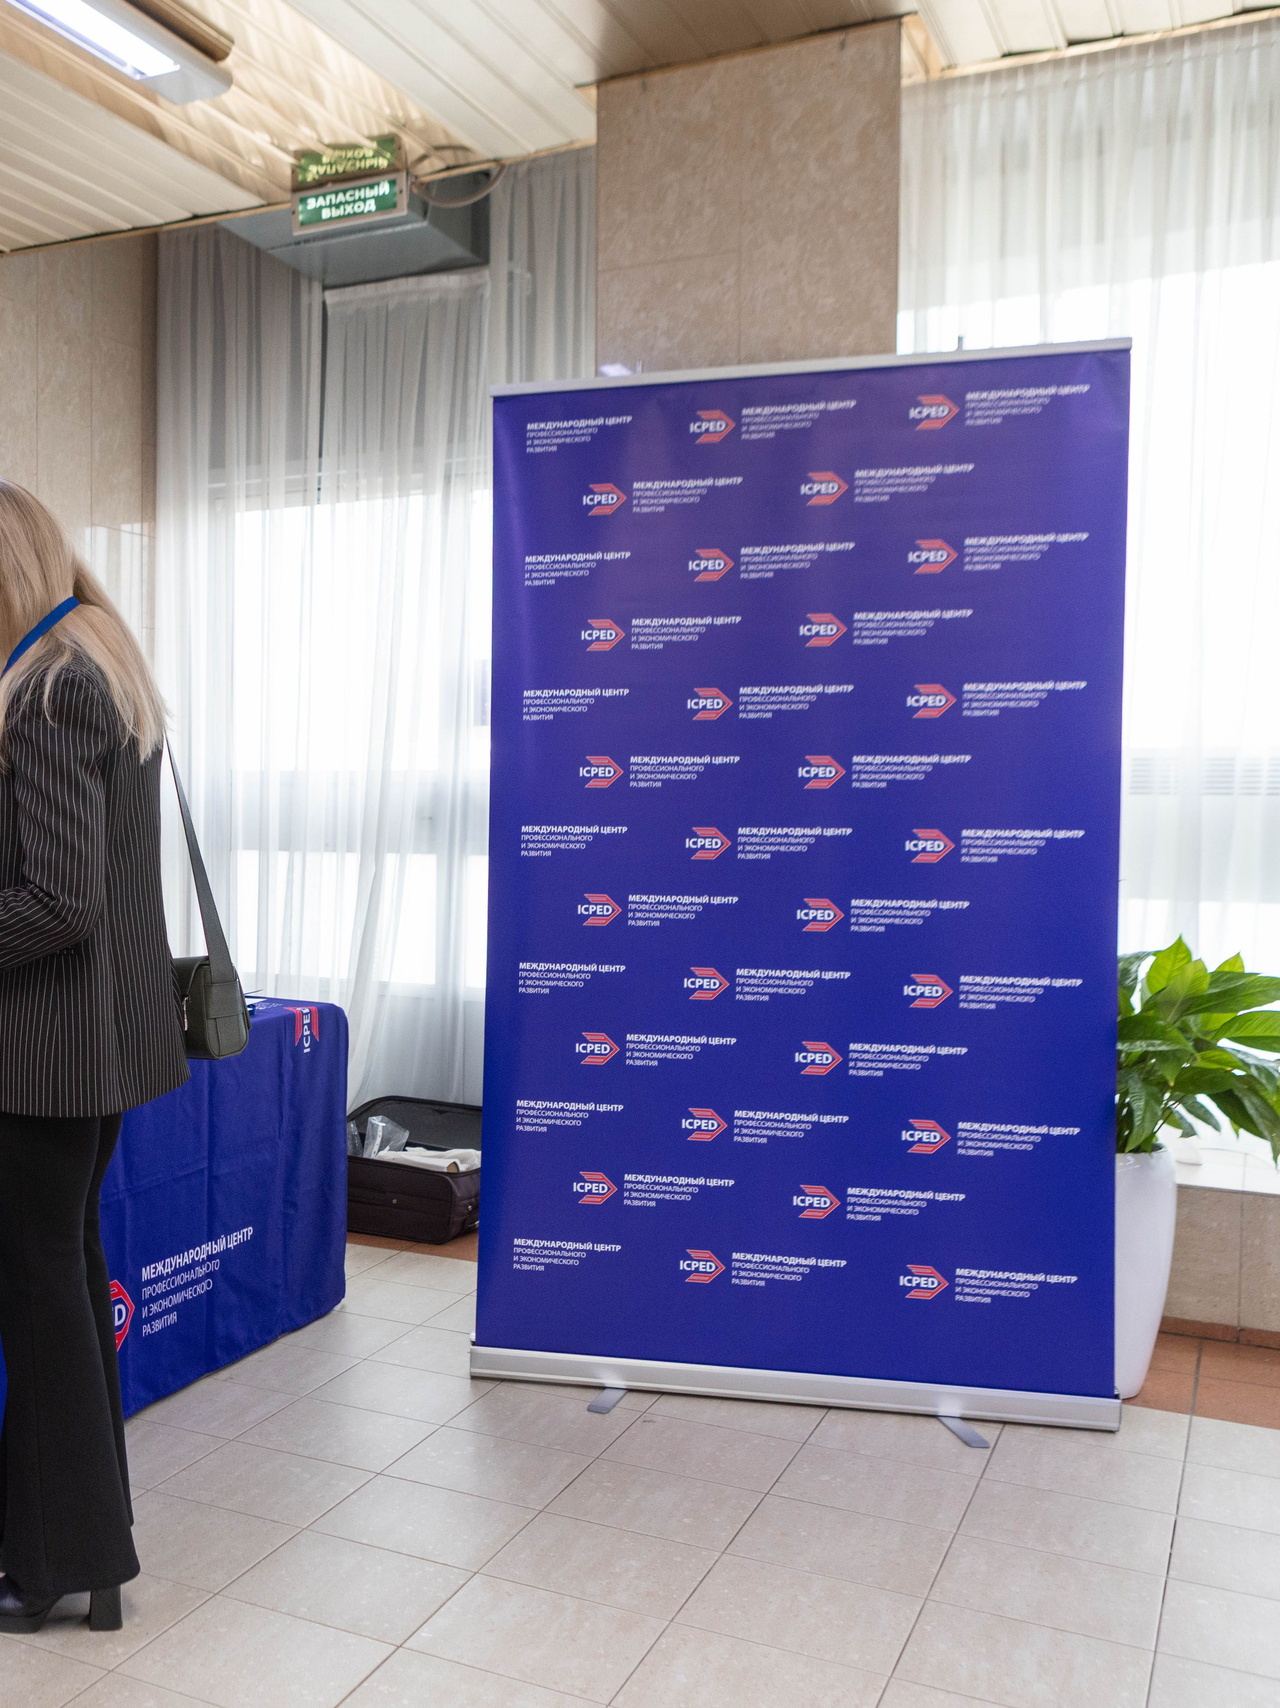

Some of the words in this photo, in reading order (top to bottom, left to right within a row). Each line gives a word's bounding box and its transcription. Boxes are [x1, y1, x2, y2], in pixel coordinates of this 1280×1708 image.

[307, 180, 390, 210] ЗАПАСНЫЙ
[321, 198, 376, 220] ВЫХОД
[910, 404, 949, 418] ICPED
[526, 417, 604, 430] МЕЖДУНАРОДНЫЙ
[605, 415, 632, 425] ЦЕНТР
[690, 420, 726, 432] ICPED
[632, 477, 713, 490] МЕЖДУНАРОДНЫЙ
[714, 476, 743, 486] ЦЕНТР
[801, 481, 838, 494] ICPED
[583, 493, 617, 505] ICPED
[740, 542, 824, 555] МЕЖДУНАРОДНЫЙ
[825, 541, 855, 551] ЦЕНТР
[524, 551, 602, 563] МЕЖДУНАРОДНЫЙ
[603, 551, 631, 560] ЦЕНТР
[908, 549, 947, 562] ICPED
[689, 559, 724, 570] ICPED
[631, 615, 712, 627] МЕЖДУНАРОДНЫЙ
[713, 615, 741, 625] ЦЕНТР
[581, 629, 615, 640] ICPED
[800, 624, 837, 635] ICPED
[523, 687, 601, 698] МЕЖДУНАРОДНЫЙ
[601, 688, 629, 697] ЦЕНТР
[739, 684, 823, 695] МЕЖДУНАРОДНЫЙ
[823, 684, 854, 693] ЦЕНТР
[522, 697, 594, 705] ПРОФЕССИОНАЛЬНОГО
[688, 698, 722, 709] ICPED
[907, 695, 946, 706] ICPED
[528, 705, 587, 713] ЭКОНОМИЧЕСКОГО
[629, 754, 710, 765] МЕЖДУНАРОДНЫЙ
[711, 755, 740, 764] ЦЕНТР
[851, 753, 939, 764] МЕЖДУНАРОДНЫЙ
[940, 754, 971, 764] ЦЕНТР
[580, 766, 614, 776] ICPED
[799, 766, 835, 777] ICPED
[521, 824, 599, 833] МЕЖДУНАРОДНЫЙ
[600, 825, 627, 834] ЦЕНТР
[737, 826, 822, 836] МЕЖДУНАРОДНЫЙ
[822, 827, 852, 836] ЦЕНТР
[686, 837, 721, 848] ICPED
[905, 840, 944, 851] ICPED
[628, 894, 709, 903] МЕЖДУНАРОДНЫЙ
[710, 895, 738, 904] ЦЕНТР
[850, 898, 938, 908] МЕЖДУНАРОДНЫЙ
[938, 900, 969, 909] ЦЕНТР
[578, 904, 612, 914] ICPED
[627, 903, 702, 911] ПРОФЕССИОНАЛЬНОГО
[634, 911, 695, 919] ЭКОНОМИЧЕСКОГО
[797, 909, 834, 920] ICPED
[518, 962, 597, 971] МЕЖДУНАРОДНЫЙ
[598, 964, 625, 972] ЦЕНТР
[518, 971, 591, 979] ПРОФЕССИОНАЛЬНОГО
[735, 968, 820, 978] МЕЖДУНАРОДНЫЙ
[821, 970, 851, 980] ЦЕНТР
[524, 979, 584, 987] ЭКОНОМИЧЕСКОГО
[684, 977, 719, 988] ICPED
[518, 986, 549, 994] РАЗВИТИЯ
[904, 985, 942, 996] ICPED
[626, 1033, 707, 1044] МЕЖДУНАРОДНЫЙ
[708, 1036, 736, 1045] ЦЕНТР
[576, 1042, 610, 1053] ICPED
[848, 1042, 936, 1053] МЕЖДУНАРОДНЫЙ
[936, 1046, 968, 1055] ЦЕНТР
[795, 1052, 832, 1063] ICPED
[516, 1099, 595, 1110] МЕЖДУНАРОДНЫЙ
[596, 1103, 623, 1112] ЦЕНТР
[515, 1108, 589, 1118] ПРОФЕССИОНАЛЬНОГО
[733, 1109, 818, 1121] МЕЖДУНАРОДНЫЙ
[819, 1114, 849, 1123] ЦЕНТР
[522, 1117, 582, 1126] ЭКОНОМИЧЕСКОГО
[682, 1118, 717, 1130] ICPED
[515, 1124, 547, 1132] РАЗВИТИЯ
[957, 1121, 1048, 1134] МЕЖДУНАРОДНЫЙ
[1048, 1126, 1080, 1135] ЦЕНТР
[902, 1130, 940, 1142] ICPED
[623, 1173, 705, 1185] МЕЖДУНАРОДНЫЙ
[706, 1178, 734, 1186] ЦЕНТР
[574, 1182, 608, 1193] ICPED
[846, 1187, 933, 1199] МЕЖДУНАРОДНЫЙ
[934, 1192, 965, 1201] ЦЕНТР
[793, 1195, 830, 1207] ICPED
[513, 1237, 592, 1250] МЕЖДУНАРОДНЫЙ
[593, 1243, 621, 1251] ЦЕНТР
[142, 1235, 226, 1282] МЕЖДУНАРОДНЫЙ
[227, 1226, 253, 1250] ЦЕНТР
[513, 1247, 586, 1258] ПРОФЕССИОНАЛЬНОГО
[519, 1255, 579, 1265] ЭКОНОМИЧЕСКОГО
[731, 1252, 816, 1265] МЕЖДУНАРОДНЫЙ
[817, 1258, 846, 1267] ЦЕНТР
[512, 1263, 544, 1271] РАЗВИТИЯ
[680, 1260, 715, 1271] ICPED
[142, 1259, 220, 1300] ПРОФЕССИОНАЛЬНОГО
[955, 1267, 1045, 1281] МЕЖДУНАРОДНЫЙ
[1046, 1274, 1077, 1283] ЦЕНТР
[900, 1275, 938, 1288] ICPED
[142, 1307, 148, 1319] И
[142, 1311, 177, 1337] РАЗВИТИЯ
